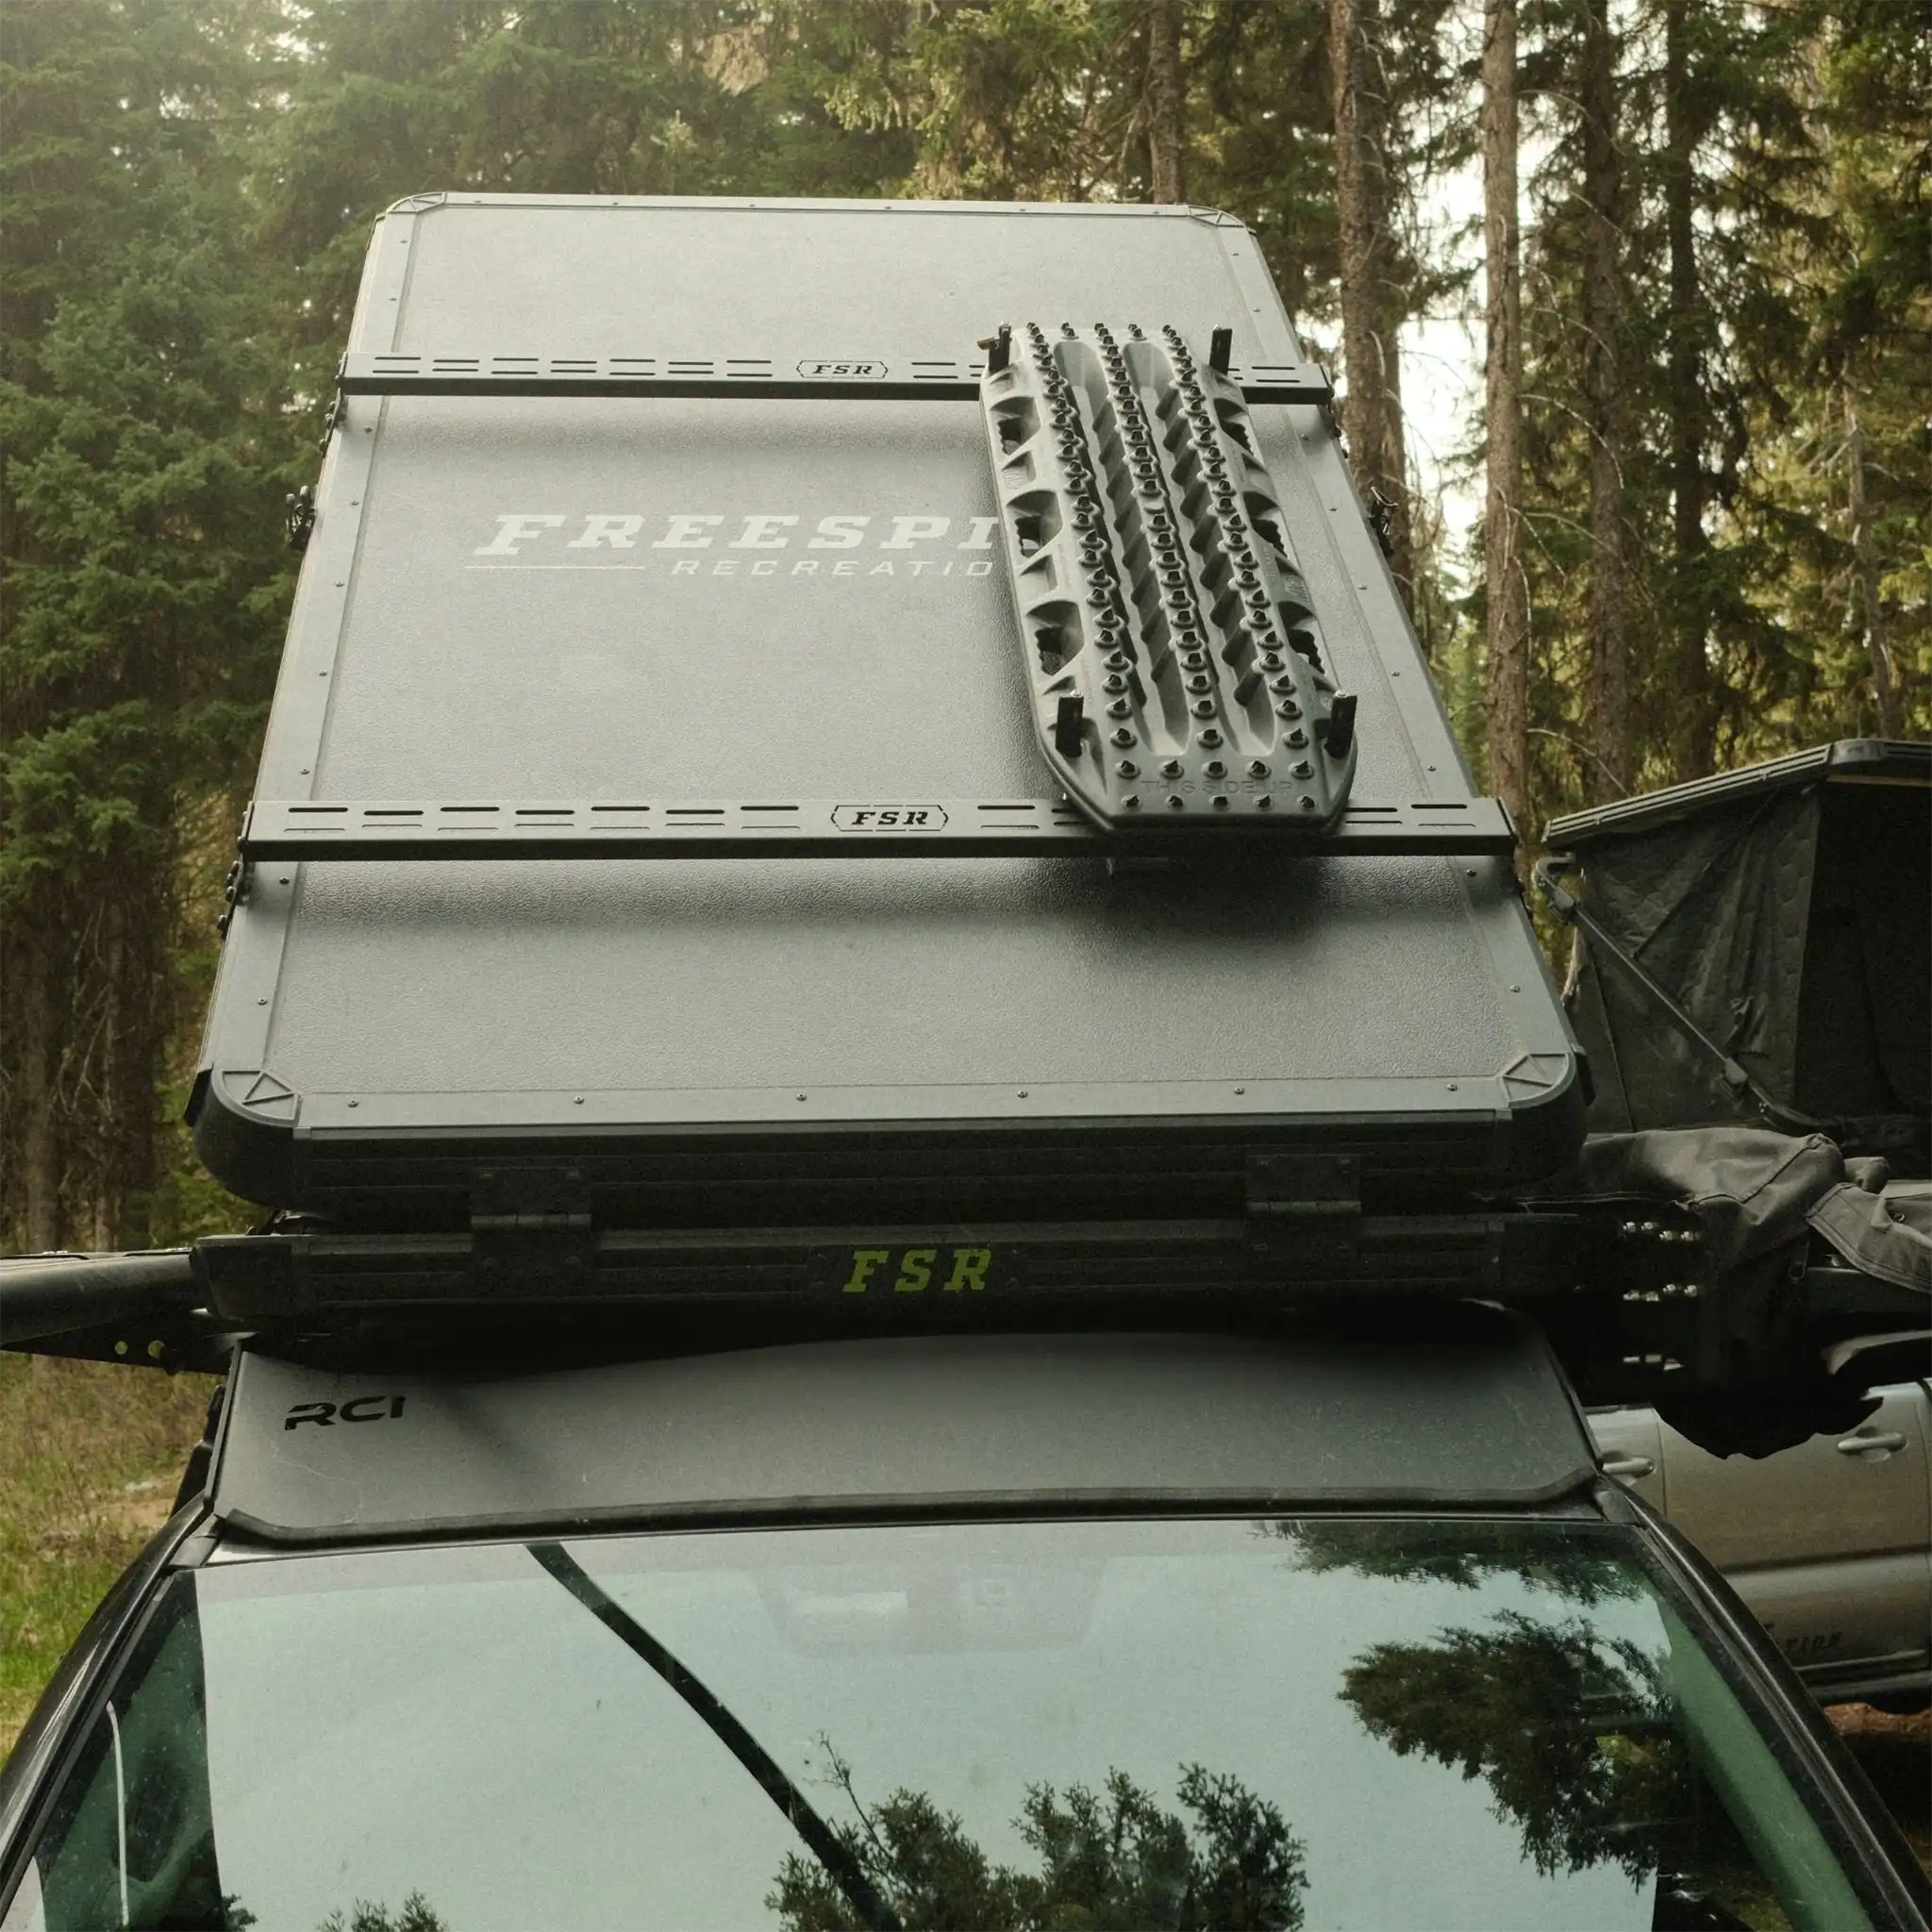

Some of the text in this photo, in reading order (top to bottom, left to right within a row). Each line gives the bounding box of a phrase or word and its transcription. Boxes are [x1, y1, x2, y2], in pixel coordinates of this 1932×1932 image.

[812, 364, 873, 375] FSR
[1141, 779, 1196, 795] THS
[1203, 779, 1257, 795] SDE
[851, 810, 928, 825] FSR
[841, 1248, 991, 1293] FSR
[284, 1395, 407, 1431] RCI
